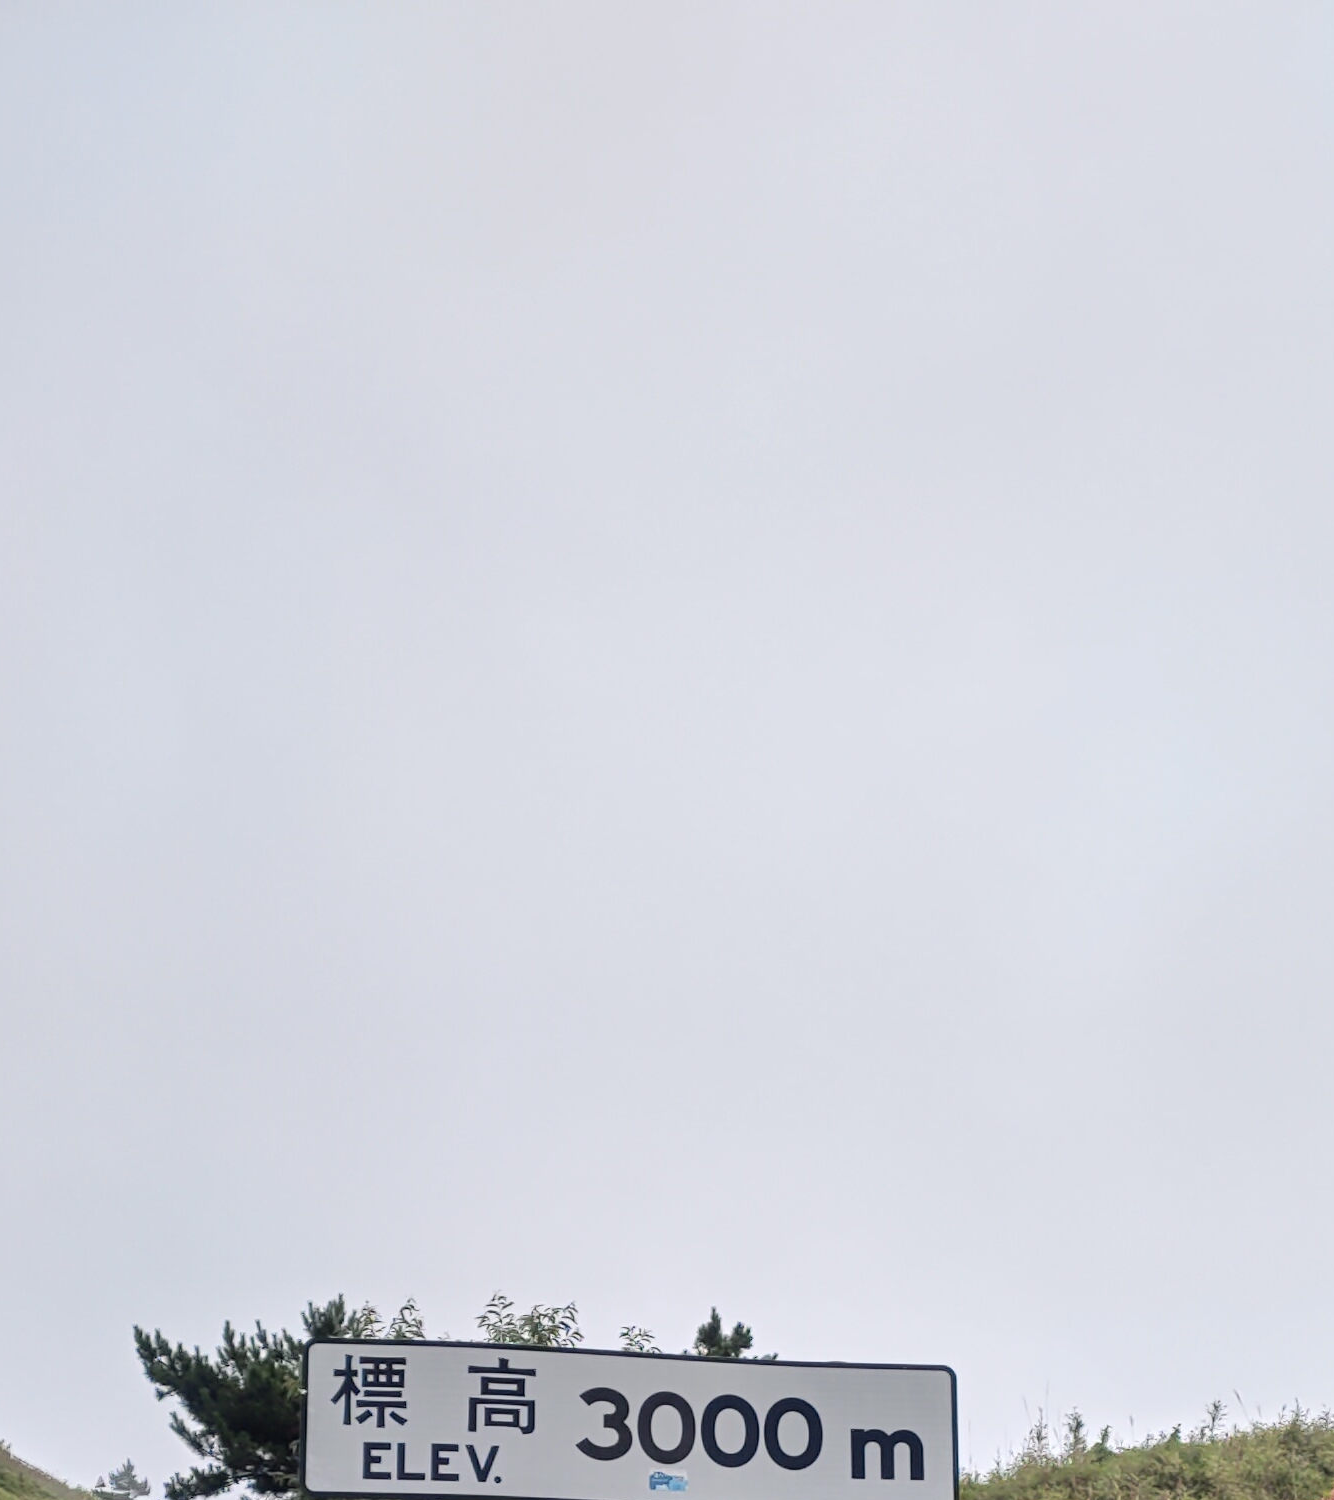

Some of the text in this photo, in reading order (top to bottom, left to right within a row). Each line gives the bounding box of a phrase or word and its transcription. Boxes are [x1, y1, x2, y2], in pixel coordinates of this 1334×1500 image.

[362, 1441, 502, 1484] ELEV.
[575, 1386, 824, 1471] 3000
[850, 1428, 925, 1481] m
